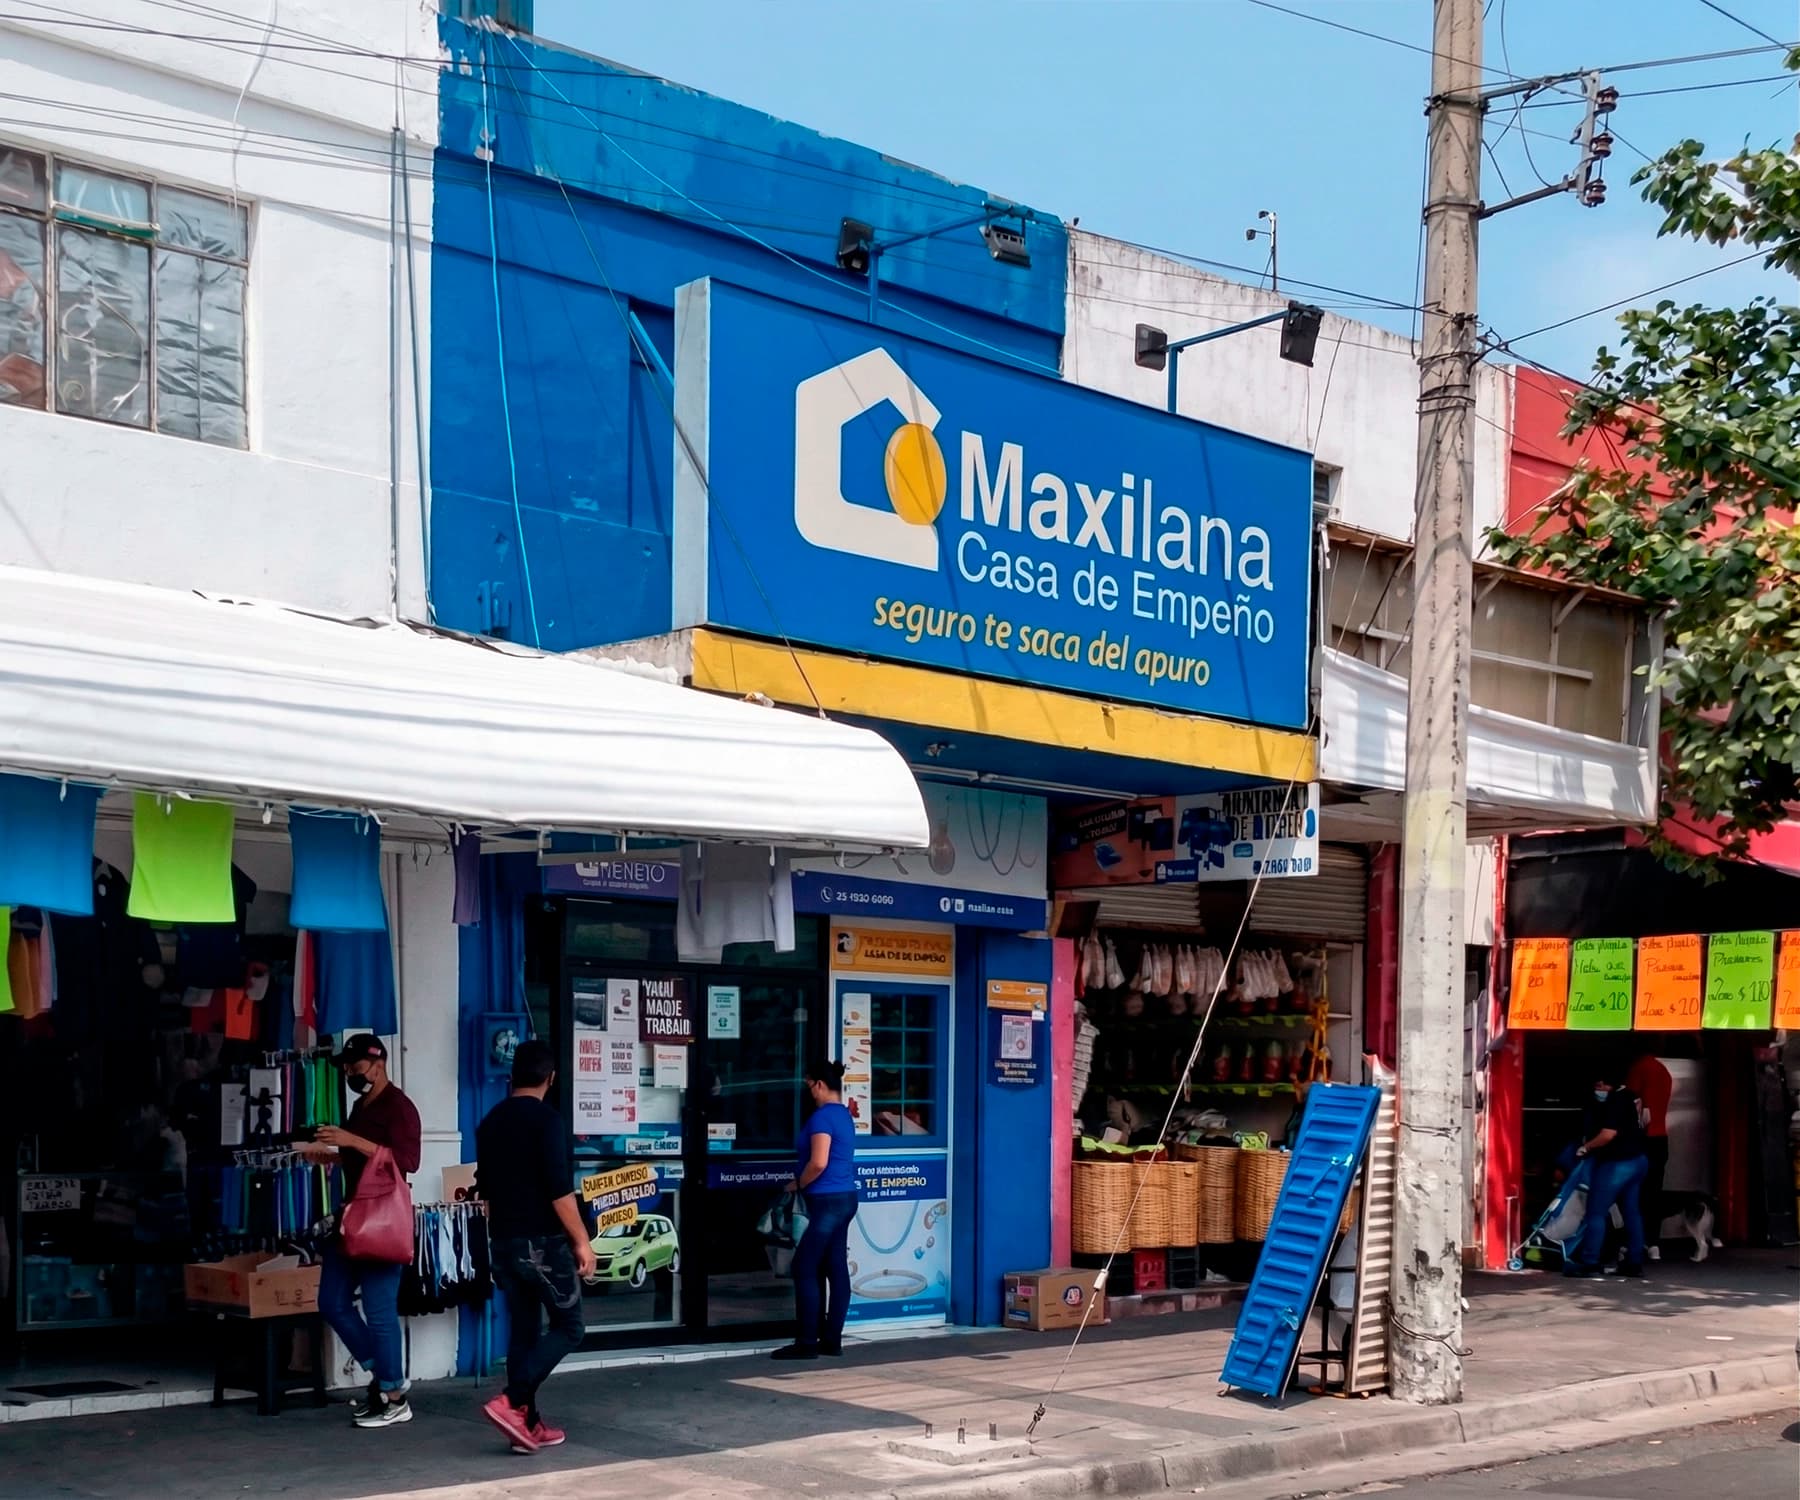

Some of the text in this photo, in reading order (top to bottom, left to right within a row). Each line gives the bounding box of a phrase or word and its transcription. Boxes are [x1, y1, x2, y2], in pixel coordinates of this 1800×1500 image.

[960, 430, 1274, 591] Maxilana
[873, 596, 1211, 686] seguro te saca del apuro
[957, 531, 1274, 644] Casa de Empeño
